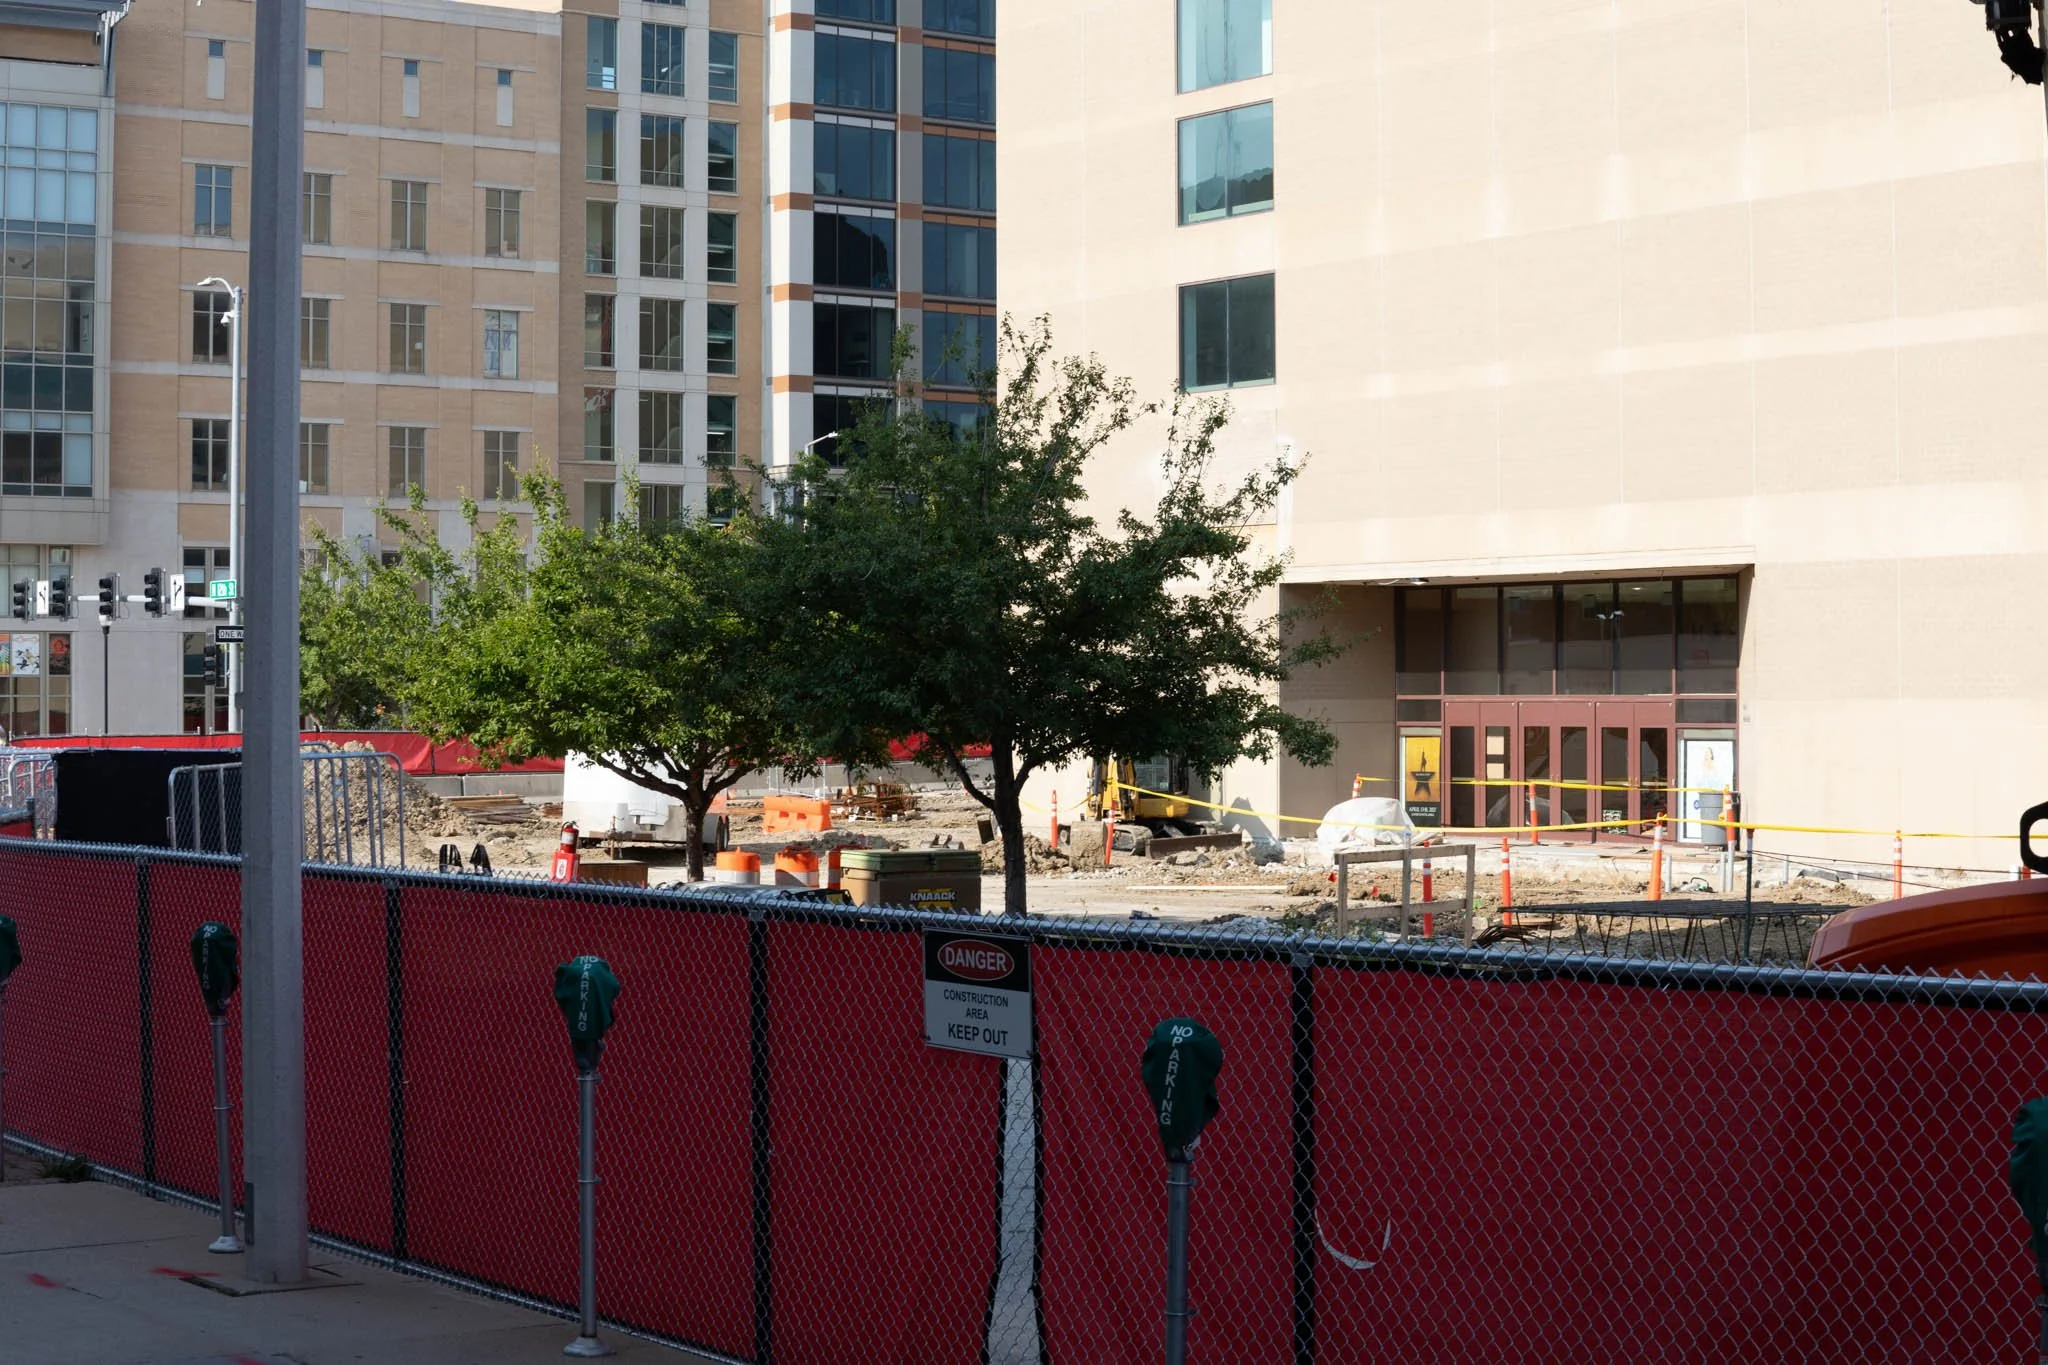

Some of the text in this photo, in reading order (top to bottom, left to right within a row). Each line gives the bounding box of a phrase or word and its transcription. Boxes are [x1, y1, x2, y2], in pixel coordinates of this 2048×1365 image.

[220, 630, 236, 638] ONE
[910, 891, 956, 901] KNAACK
[203, 925, 218, 933] NO
[579, 955, 599, 965] NO
[944, 946, 1008, 972] DANGER
[577, 963, 593, 1032] PARKING
[943, 988, 1009, 1007] CONSTRUCTION
[965, 1007, 989, 1021] AREA
[948, 1022, 1009, 1046] KEEP OUT
[1170, 1024, 1193, 1038] NO
[1160, 1036, 1183, 1125] PARKING
